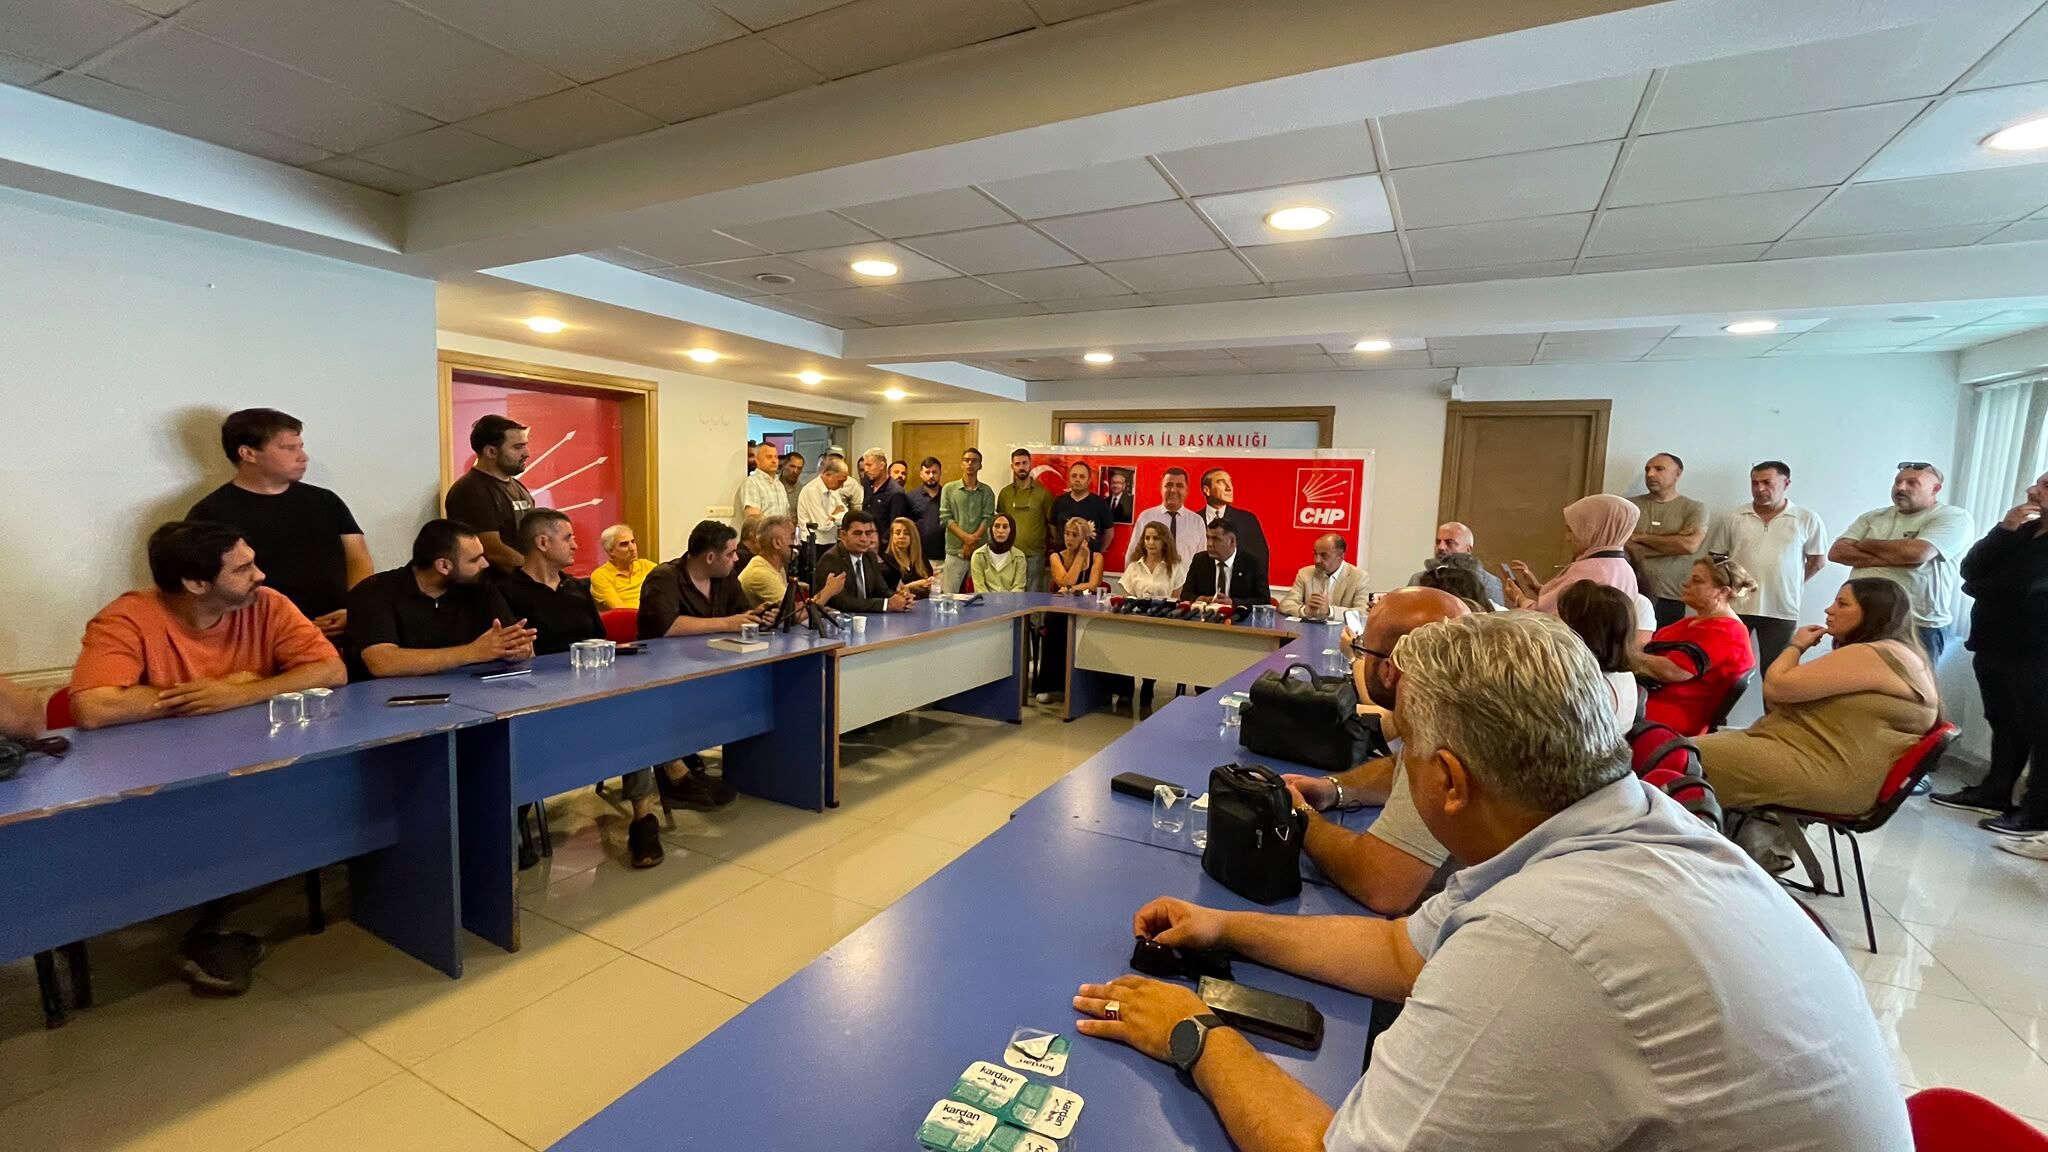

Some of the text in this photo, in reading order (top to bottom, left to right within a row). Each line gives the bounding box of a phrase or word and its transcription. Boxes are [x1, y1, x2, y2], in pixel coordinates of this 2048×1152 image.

[1106, 432, 1154, 446] MANİSA
[1161, 432, 1172, 446] İL
[1300, 507, 1345, 525] CHP
[980, 1065, 1014, 1084] kardan
[943, 1104, 981, 1121] kardan
[1054, 1099, 1076, 1127] kardan
